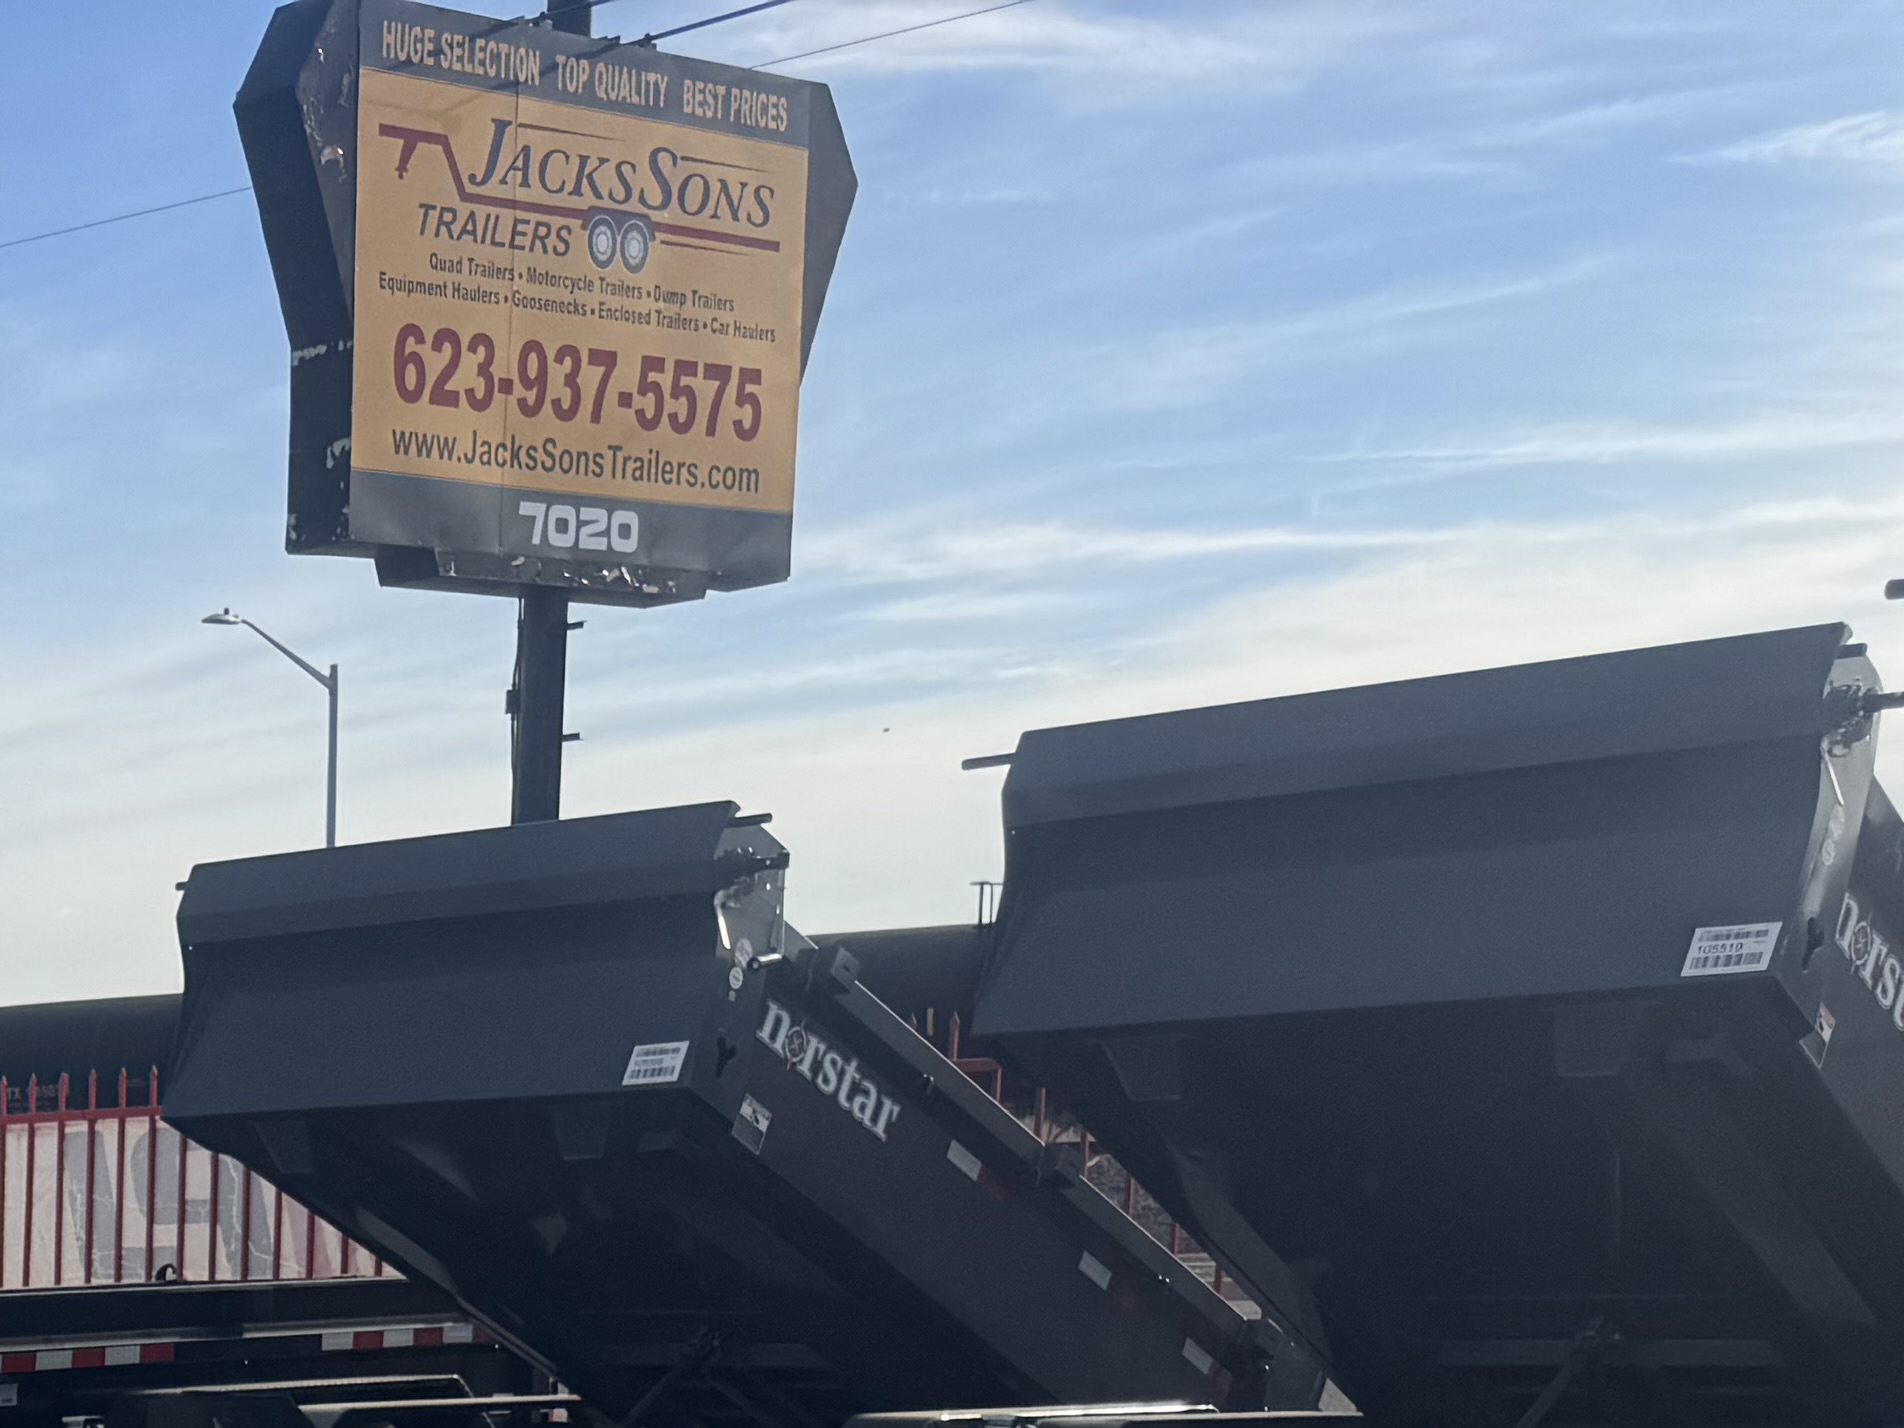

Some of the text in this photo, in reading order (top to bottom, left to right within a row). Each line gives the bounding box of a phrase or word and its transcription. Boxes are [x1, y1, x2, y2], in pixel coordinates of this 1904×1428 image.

[382, 20, 788, 132] HUGE SELECTION TOP QUALITY BEST PRICES
[418, 203, 573, 258] TRAILERS
[379, 270, 776, 343] Equipment Haulers Goosenecks Enclosed Trailers Car Haulers
[429, 252, 735, 313] Quad Trailers Motorcycle Trailers Dump Trailers
[393, 322, 763, 442] 623-937-5575
[392, 428, 761, 494] www.JacksSonsTrailers.com
[518, 501, 639, 553] 7020
[756, 1000, 901, 1143] norstar
